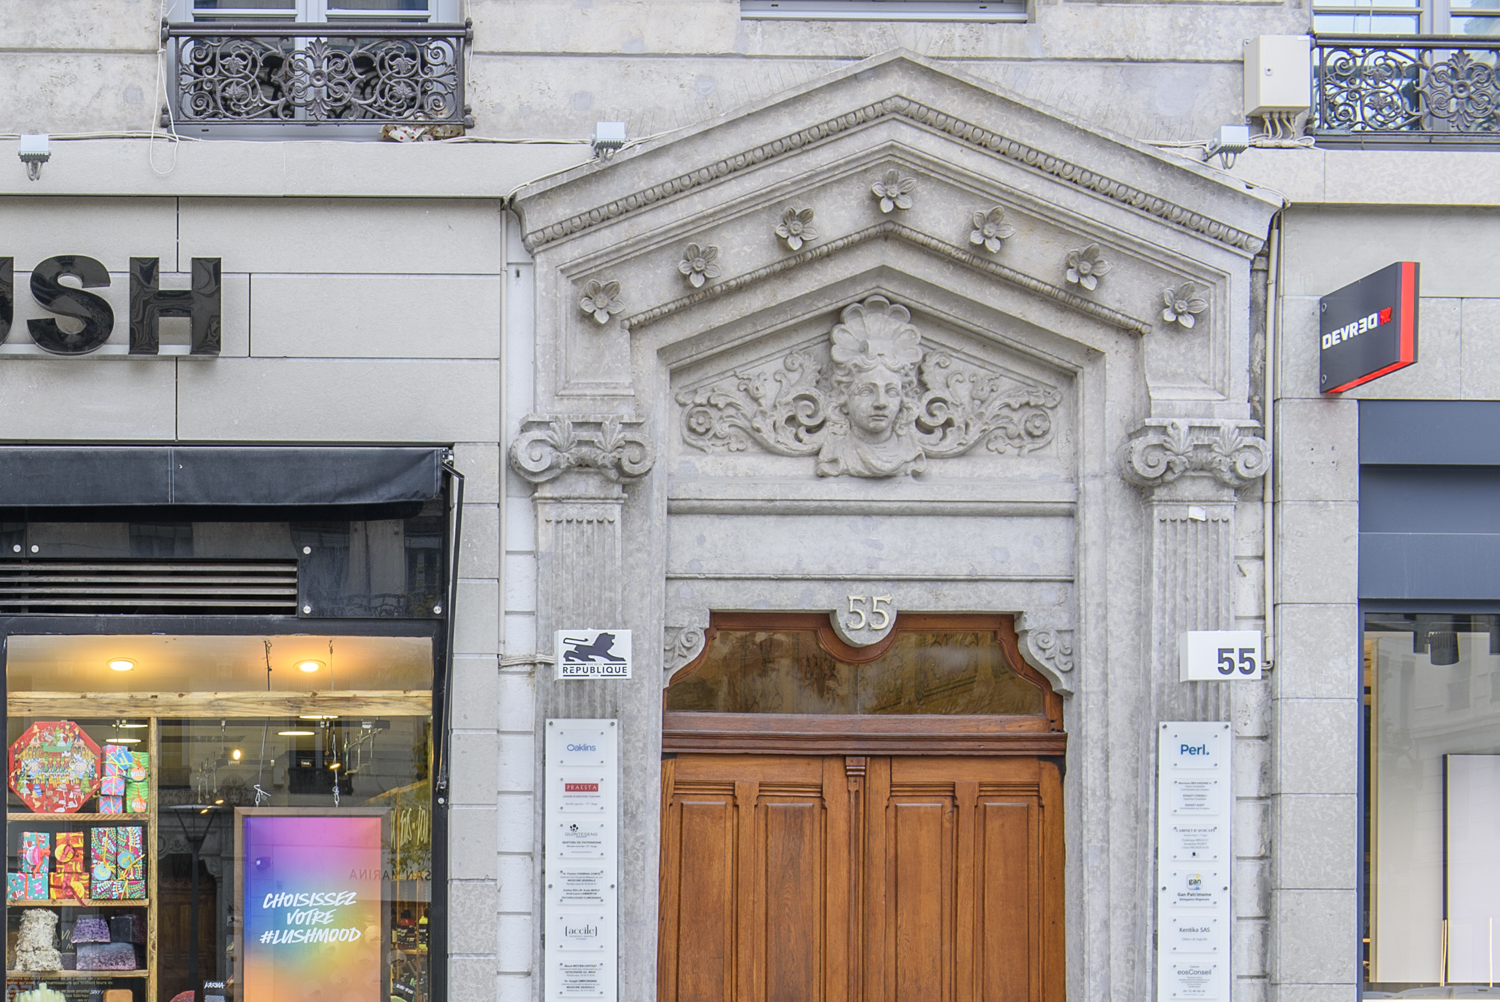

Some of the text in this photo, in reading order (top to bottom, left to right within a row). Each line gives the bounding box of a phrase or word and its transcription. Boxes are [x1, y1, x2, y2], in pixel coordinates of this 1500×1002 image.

[846, 594, 893, 631] 55
[1217, 648, 1256, 675] 55
[567, 743, 597, 752] Oaklins
[1180, 744, 1210, 755] Perl.
[1189, 878, 1202, 886] gan
[263, 891, 357, 909] CHOISISSEZ
[286, 908, 337, 925] VOTRE
[260, 927, 362, 945] #LUSHMOOD
